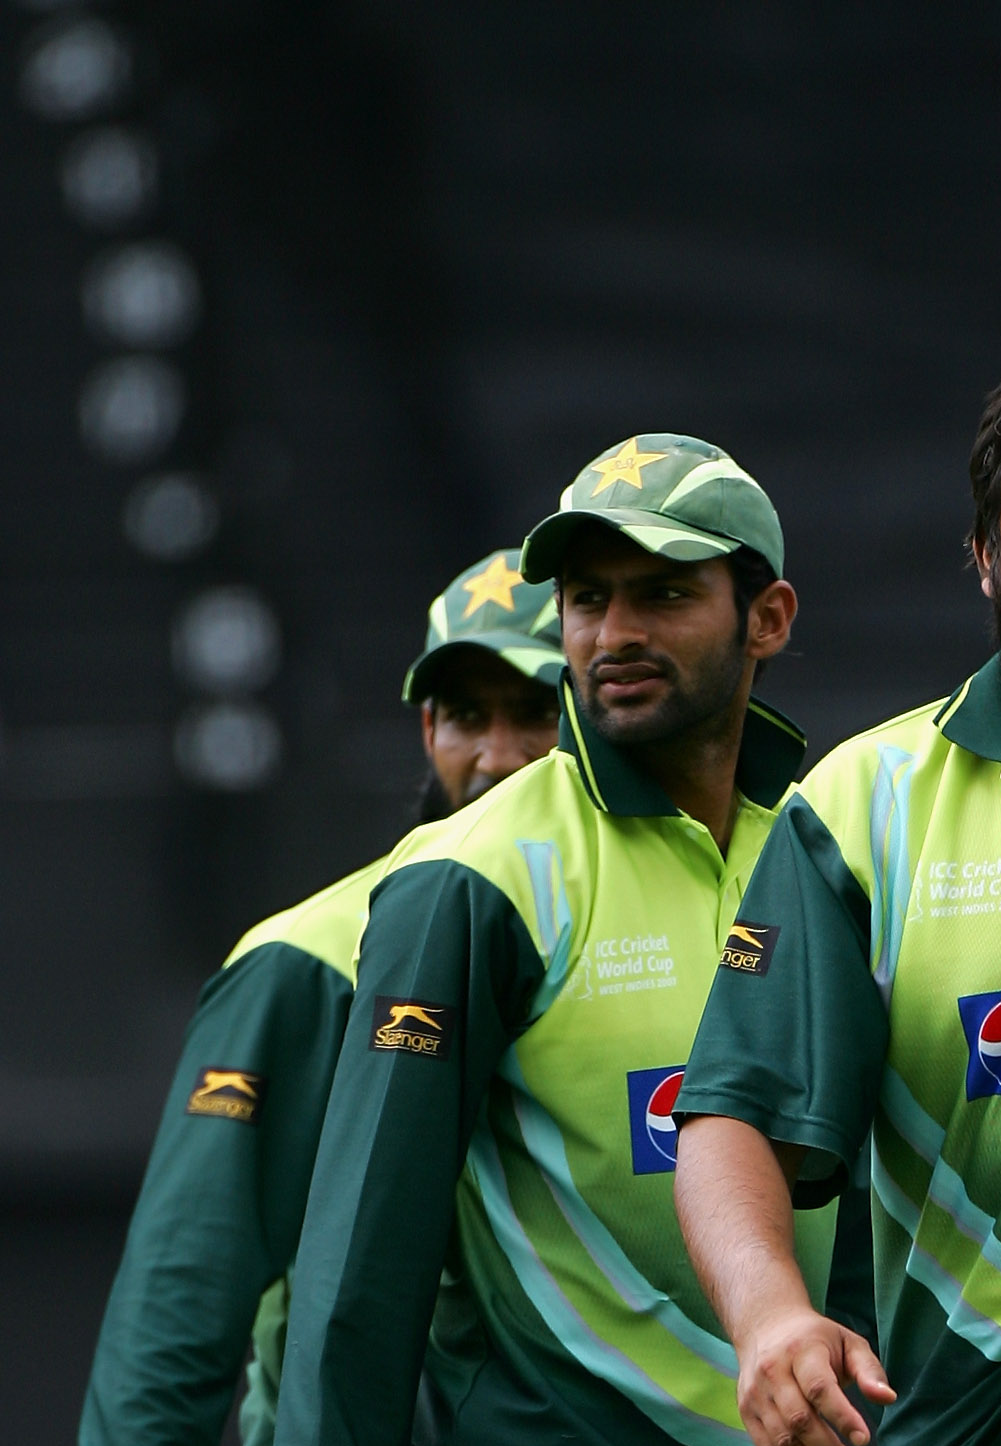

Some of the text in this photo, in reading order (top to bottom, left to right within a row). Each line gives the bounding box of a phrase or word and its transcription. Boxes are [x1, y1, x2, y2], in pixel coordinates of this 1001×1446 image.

[929, 861, 957, 879] ICC
[929, 880, 985, 901] World
[930, 906, 958, 918] WEST
[961, 902, 995, 915] INDIES
[595, 933, 670, 958] ICC Cricket
[596, 954, 674, 980] World Cup
